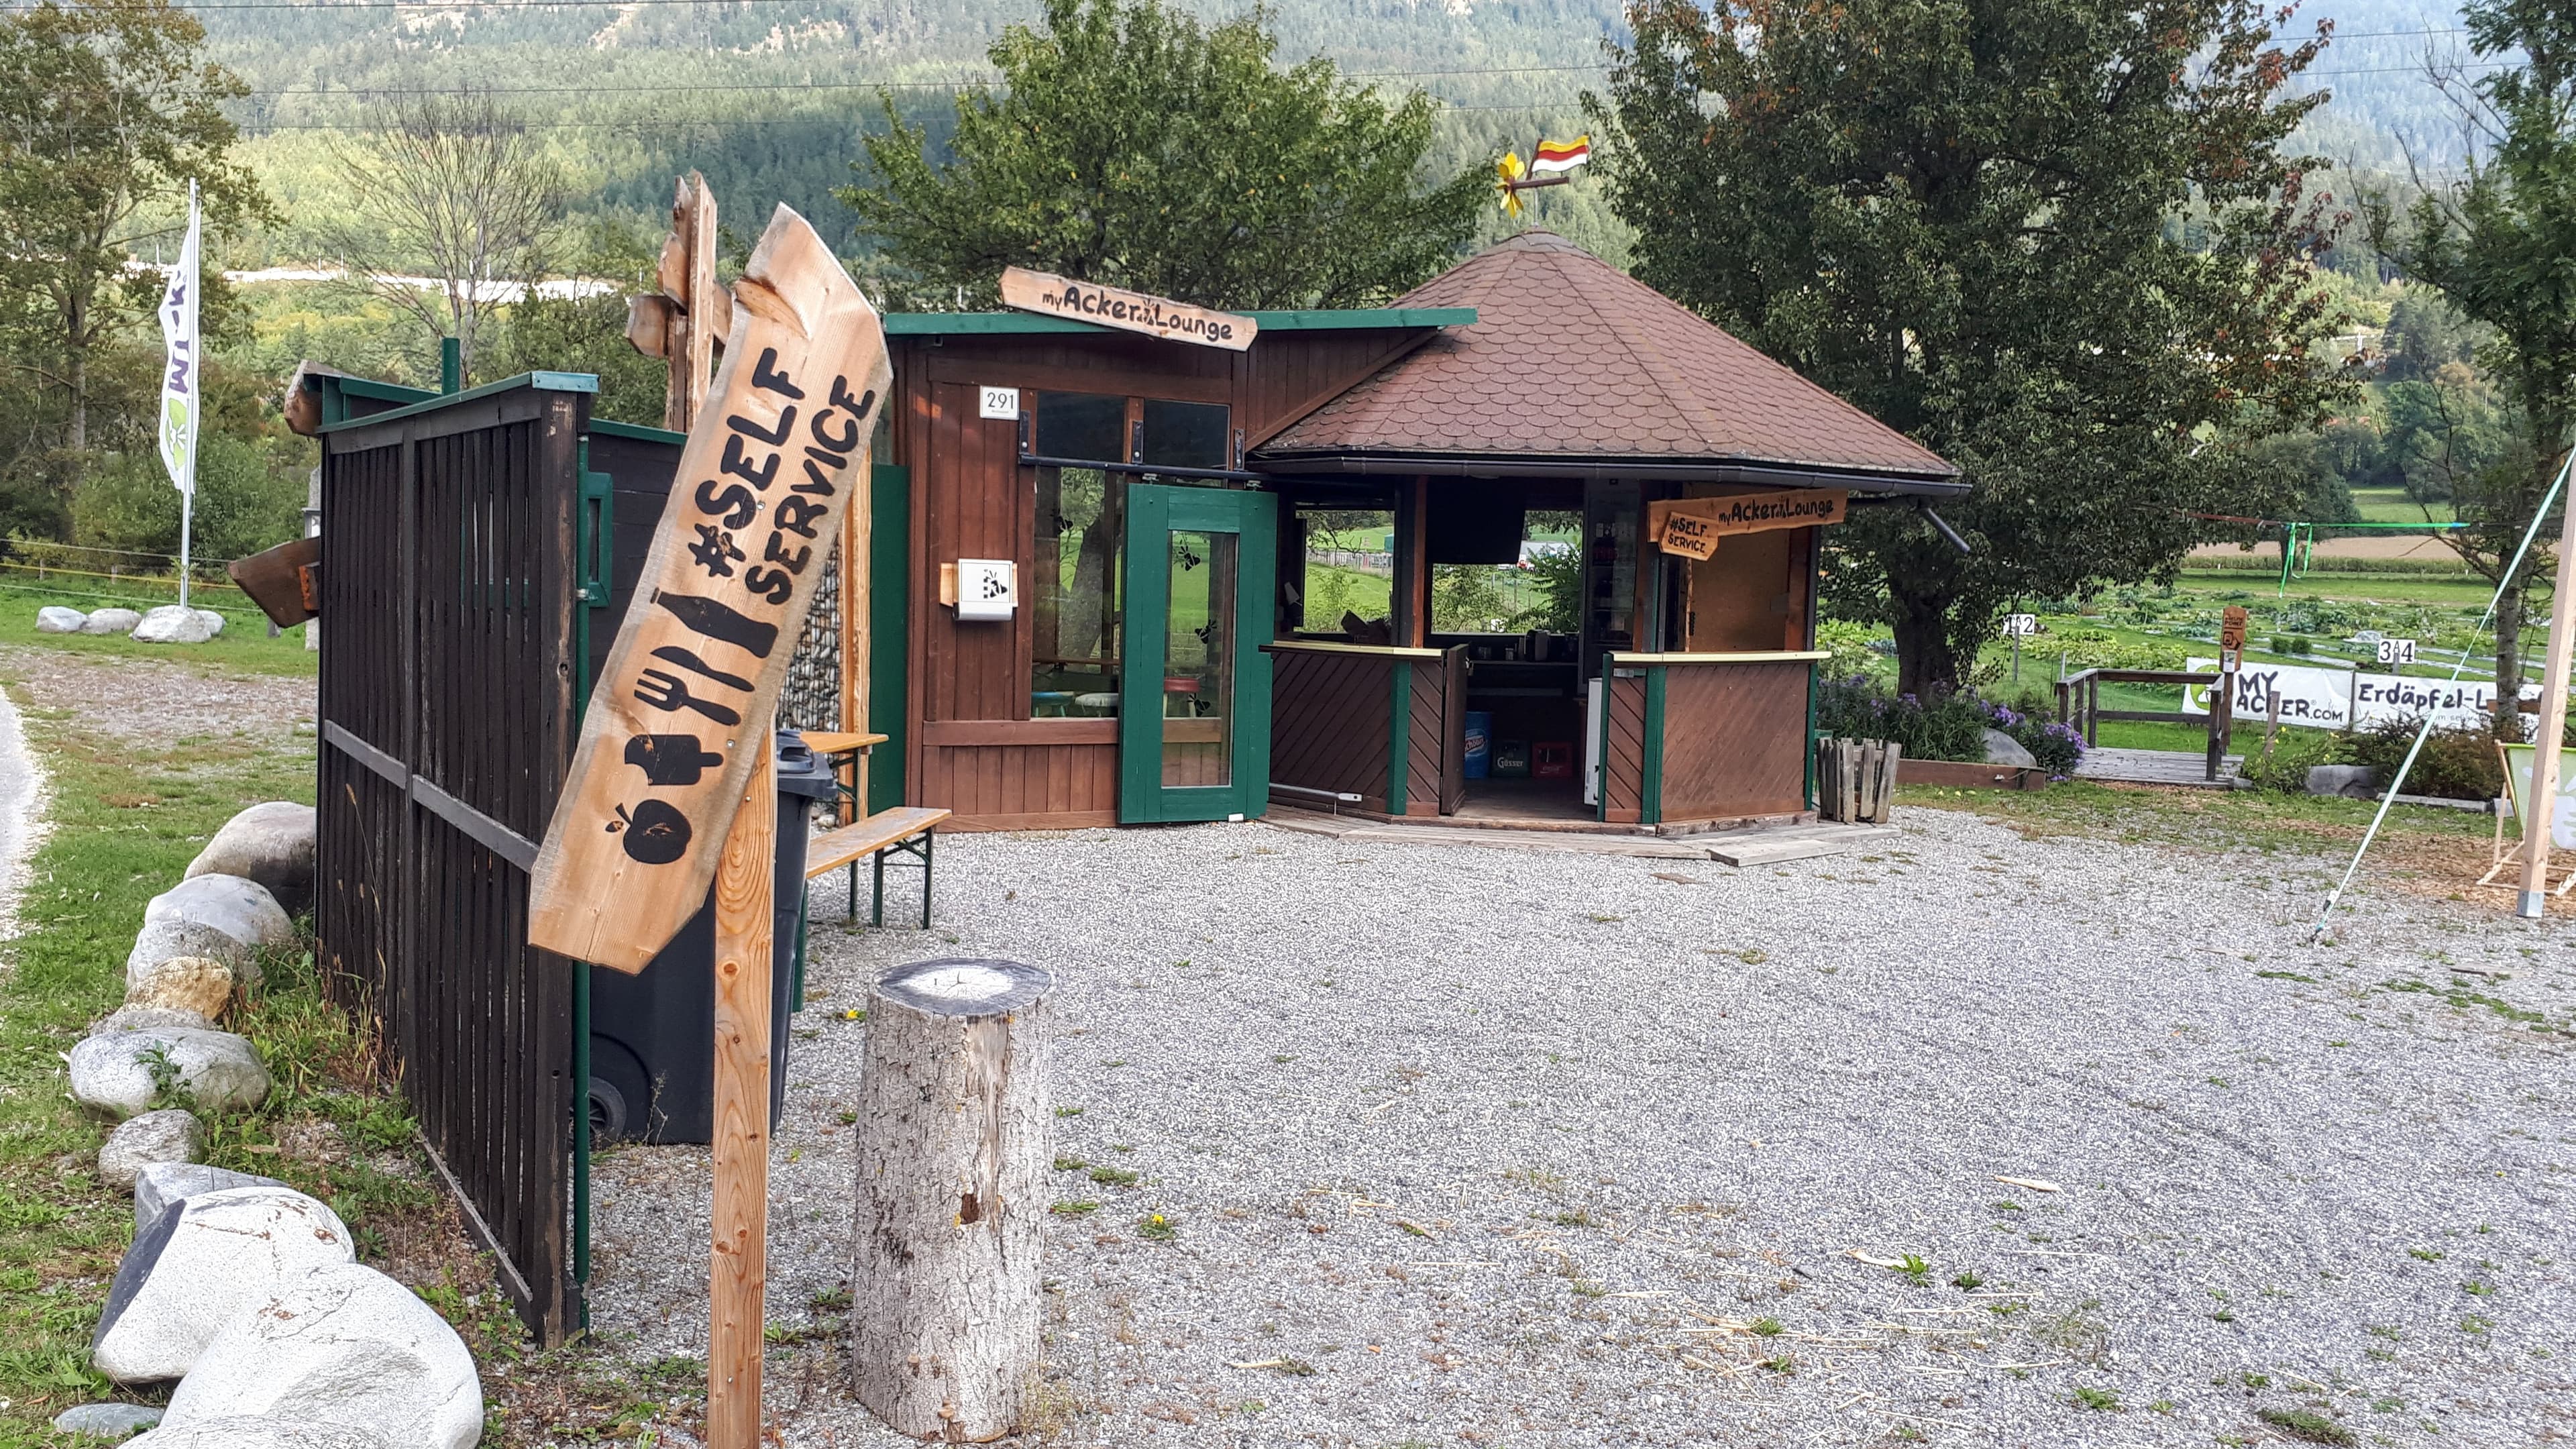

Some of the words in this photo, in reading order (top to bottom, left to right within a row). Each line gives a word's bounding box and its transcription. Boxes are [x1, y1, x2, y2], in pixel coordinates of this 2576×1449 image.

[1155, 304, 1233, 342] Lounge
[987, 392, 1014, 409] 291
[688, 347, 806, 578] #SELF
[745, 374, 875, 605] SERVICE
[1786, 498, 1833, 518] Lounge
[1670, 517, 1707, 537] #SELF
[1668, 533, 1706, 553] SERVICE
[2239, 671, 2278, 696] MY
